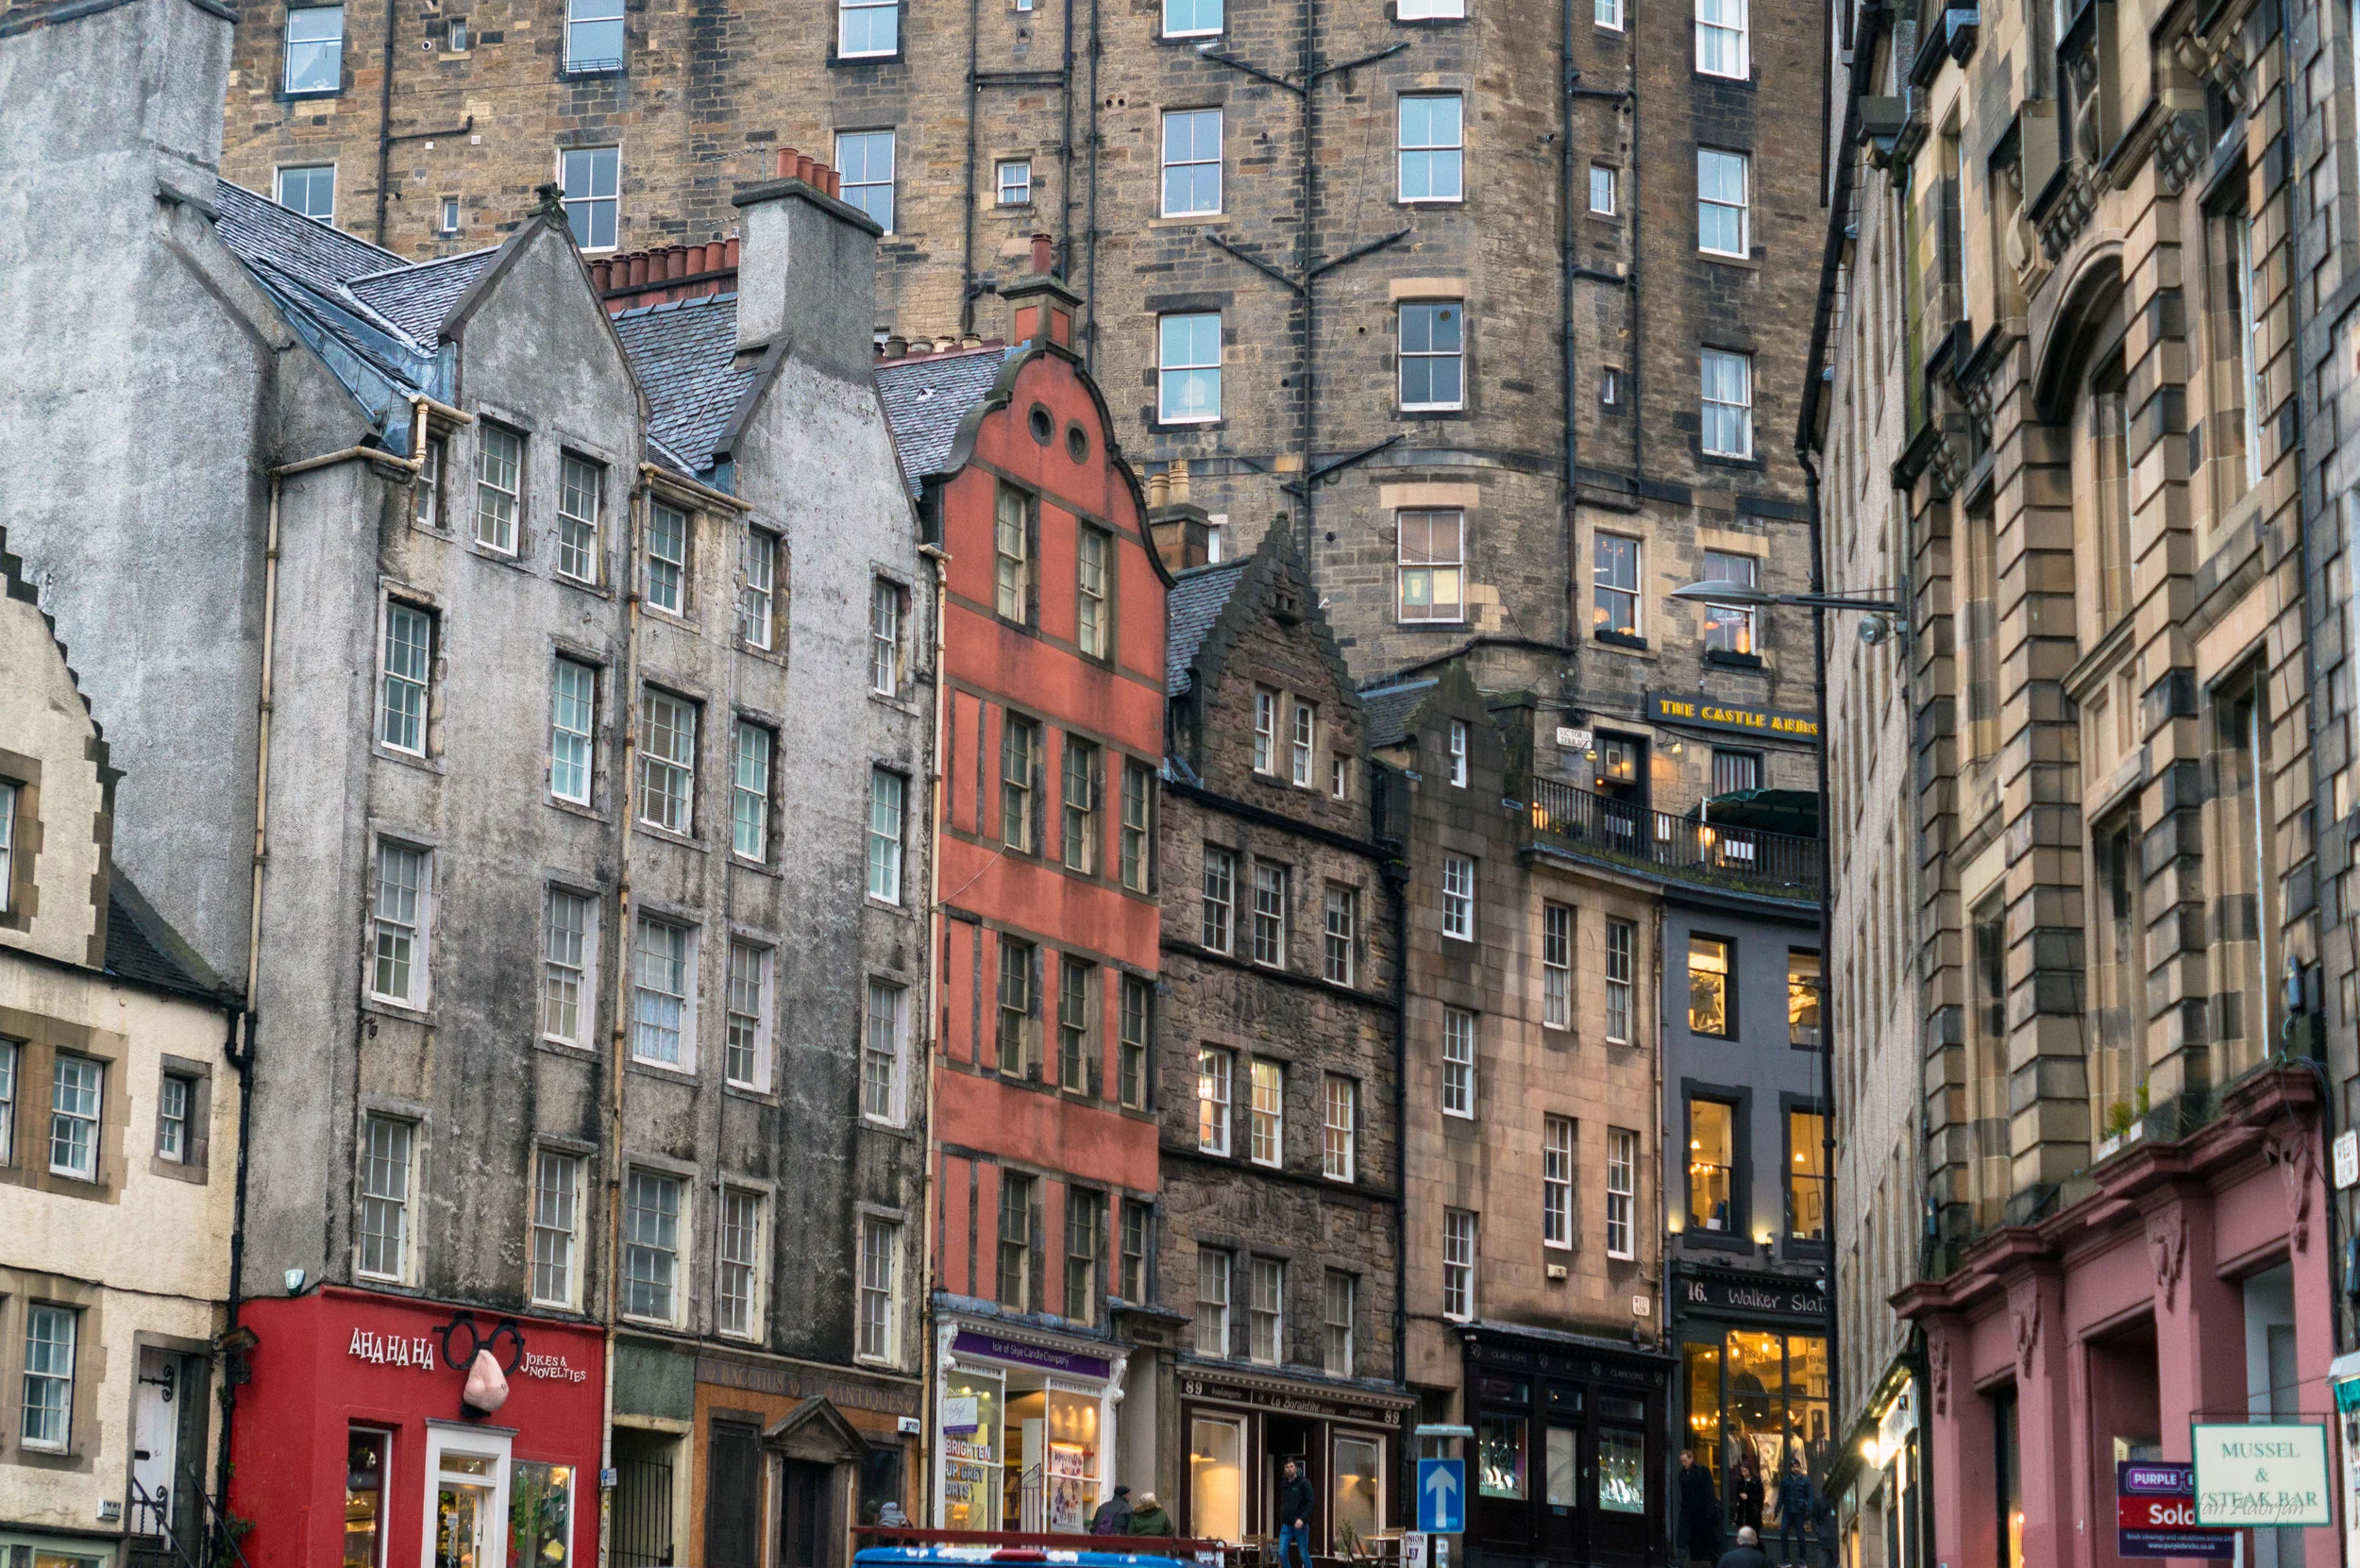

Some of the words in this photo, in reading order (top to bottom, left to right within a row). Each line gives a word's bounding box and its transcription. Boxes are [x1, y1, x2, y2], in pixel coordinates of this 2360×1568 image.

[1660, 699, 1695, 717] THE
[1701, 706, 1765, 728] CASTLE
[1559, 728, 1591, 740] VICTORIA
[1634, 1297, 1648, 1307] WEST
[1728, 1288, 1781, 1308] Walker
[1791, 1293, 1826, 1312] Slat
[992, 1340, 1003, 1352] Isle
[1003, 1343, 1009, 1355] of
[1010, 1344, 1023, 1358] Skye
[1023, 1347, 1043, 1360] Candle
[1043, 1351, 1070, 1367] Company
[520, 1352, 558, 1373] JOKES
[560, 1356, 567, 1367] &
[529, 1365, 587, 1383] NOVELTIES
[720, 1364, 785, 1391] BACCHUS
[837, 1386, 903, 1411] ANTIQUES
[1186, 1380, 1203, 1396] 89
[1271, 1395, 1281, 1408] La
[1384, 1409, 1400, 1425] 89
[946, 1440, 990, 1460] BRIGHTEN
[2221, 1442, 2301, 1458] MUSSEL
[947, 1463, 957, 1476] UP
[961, 1465, 985, 1483] GREY
[2133, 1475, 2177, 1485] PURPLE
[2255, 1467, 2269, 1482] &
[946, 1480, 969, 1499] DAYS
[2209, 1492, 2271, 1508] STEAK
[2278, 1492, 2318, 1508] BAR
